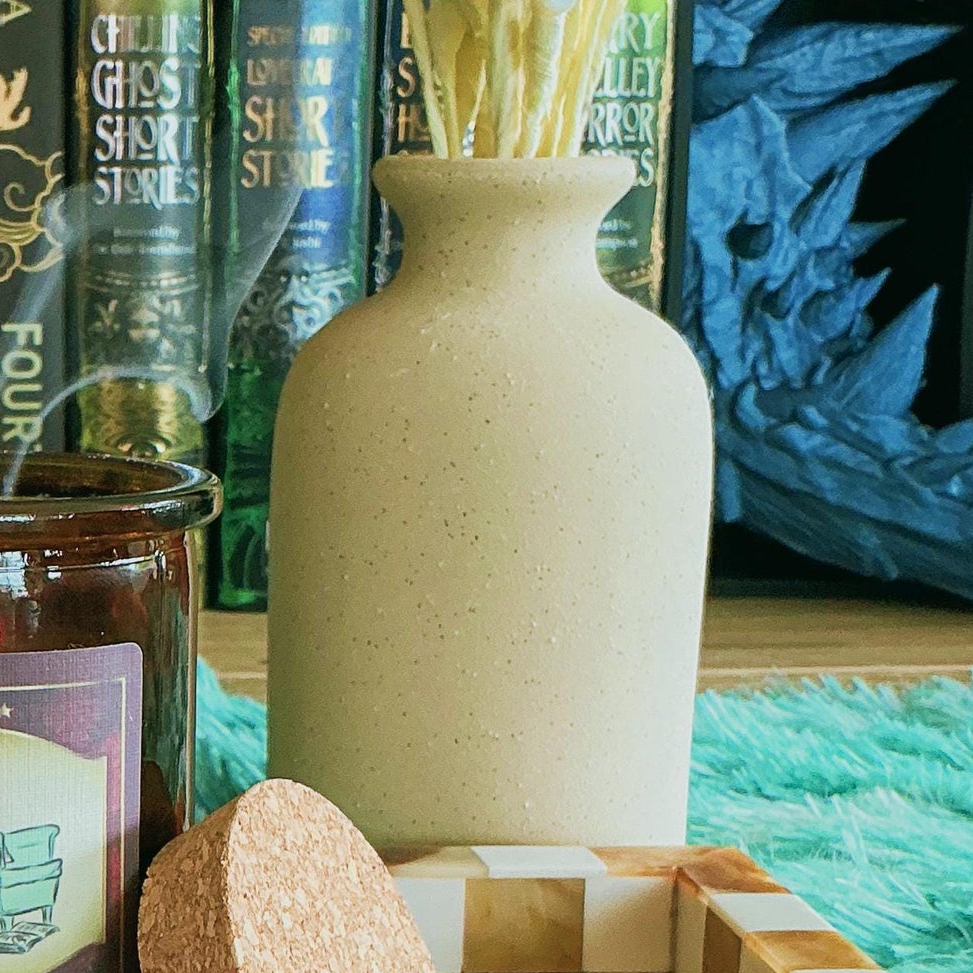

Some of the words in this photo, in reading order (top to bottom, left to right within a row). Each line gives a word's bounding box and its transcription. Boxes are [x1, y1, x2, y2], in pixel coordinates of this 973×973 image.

[91, 58, 201, 109] GHOST
[94, 112, 200, 166] SHORT
[587, 102, 655, 147] RROR
[92, 165, 200, 210] STORIES
[1, 322, 44, 453] FOUR
